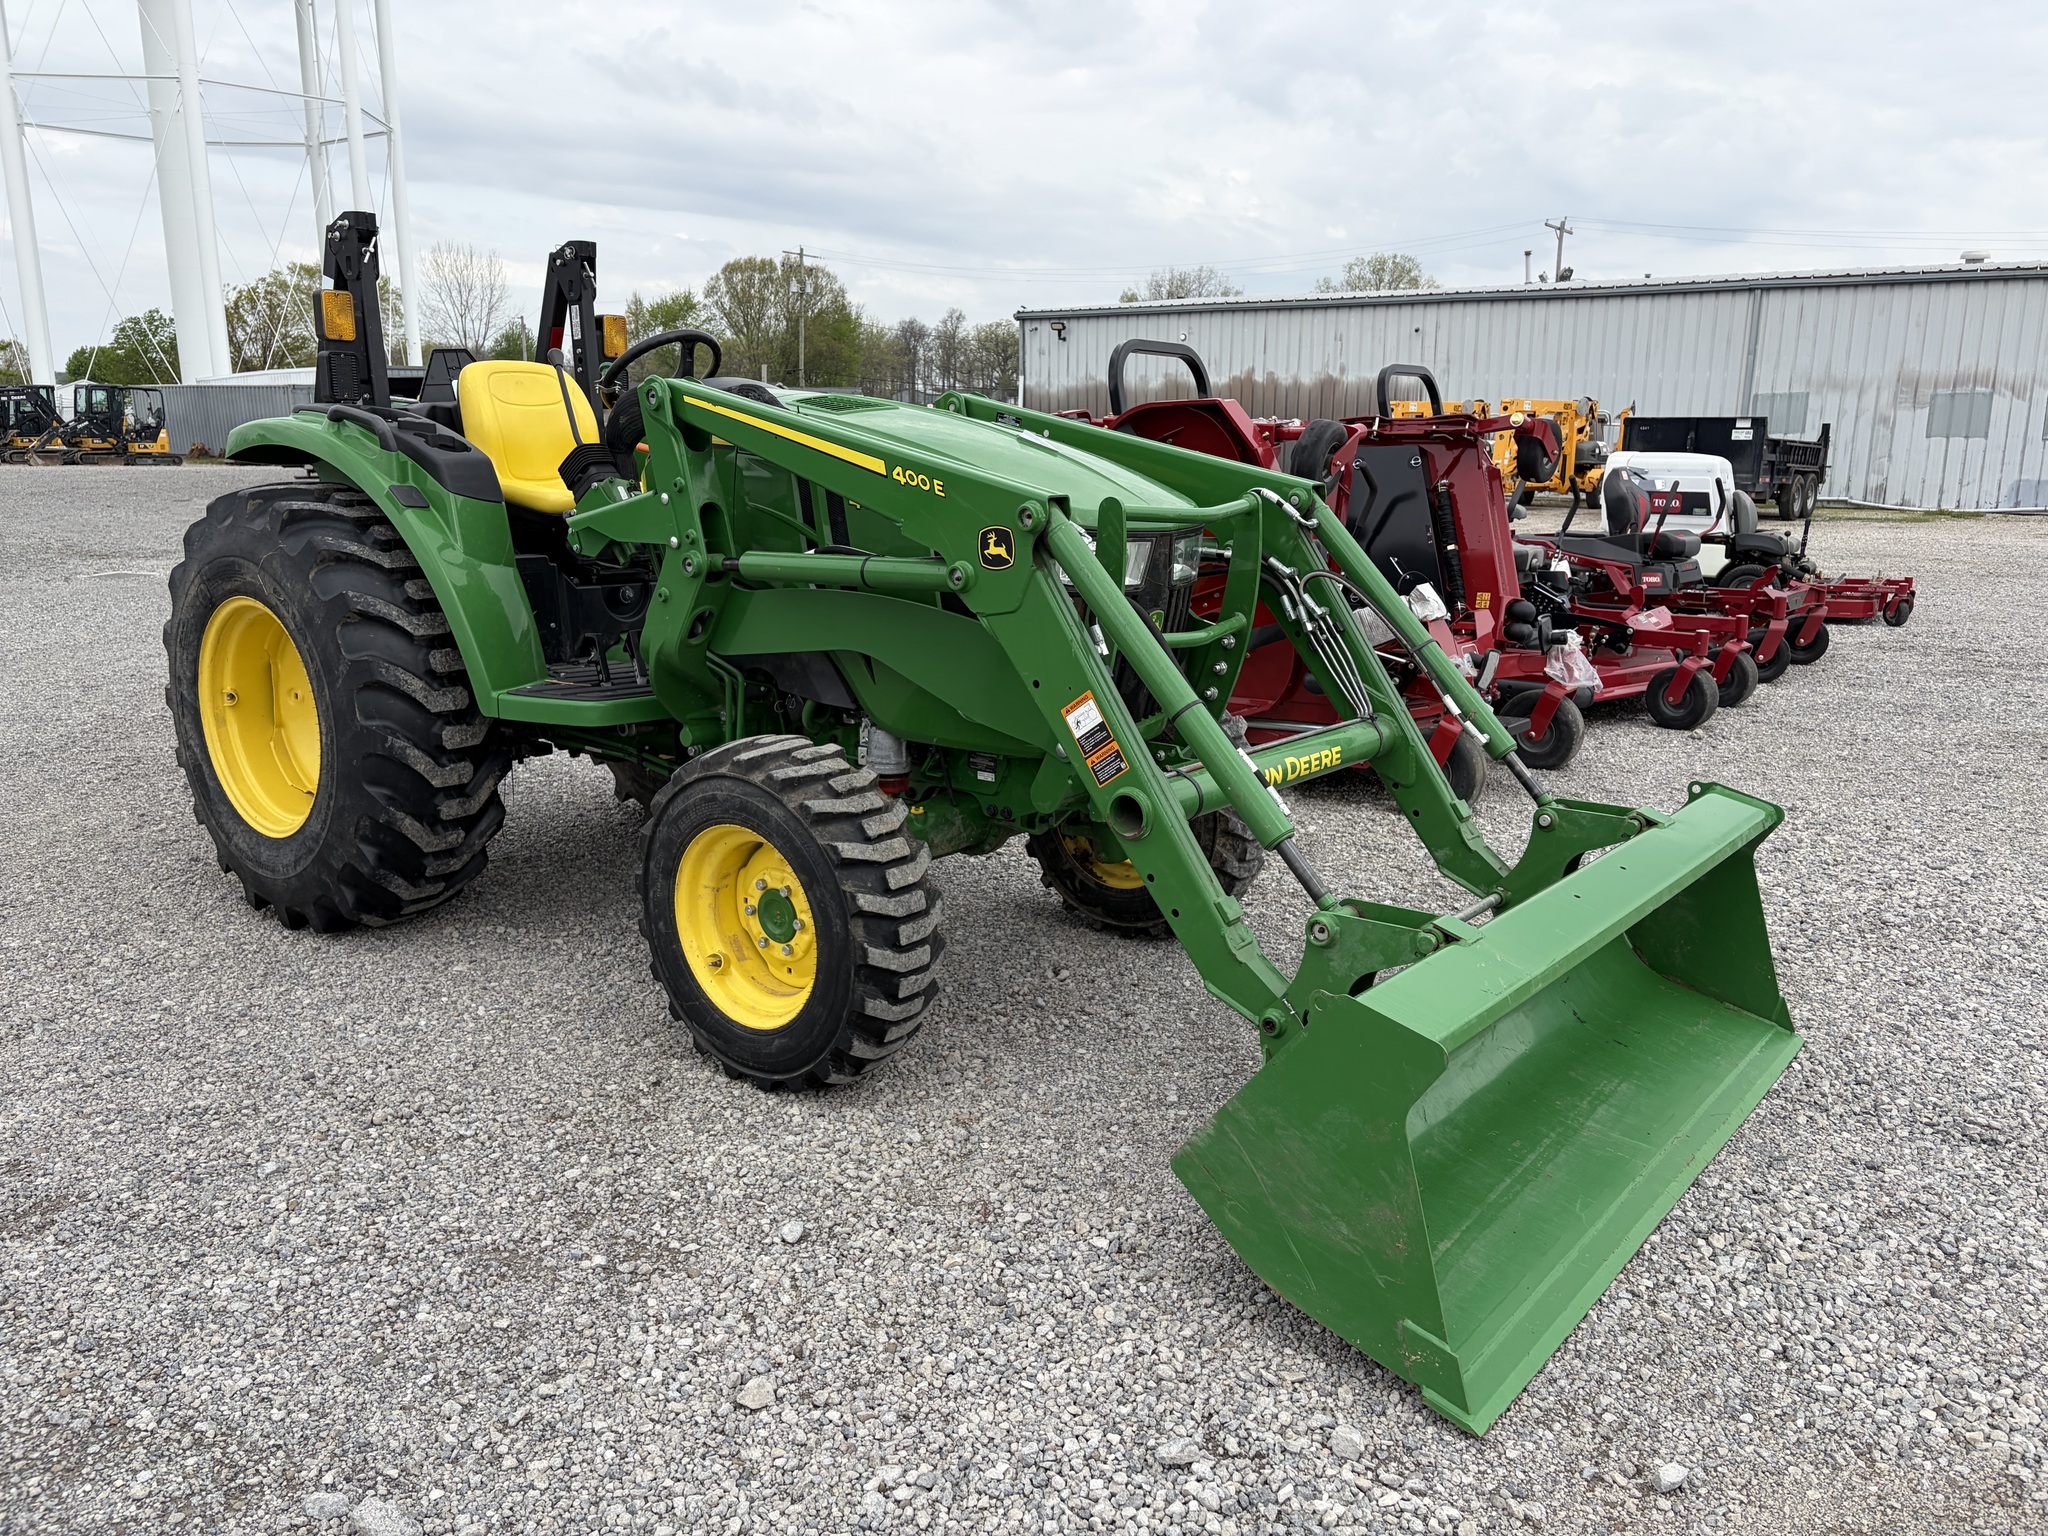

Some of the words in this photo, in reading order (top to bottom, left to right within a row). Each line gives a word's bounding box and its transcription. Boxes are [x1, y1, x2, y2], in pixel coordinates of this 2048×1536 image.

[892, 465, 930, 491] 400
[932, 478, 946, 497] E
[1652, 498, 1680, 508] TOO
[1547, 550, 1579, 563] TAN
[1069, 694, 1089, 711] WARNING
[1095, 745, 1116, 761] WARNING
[1284, 745, 1342, 781] DEERE
